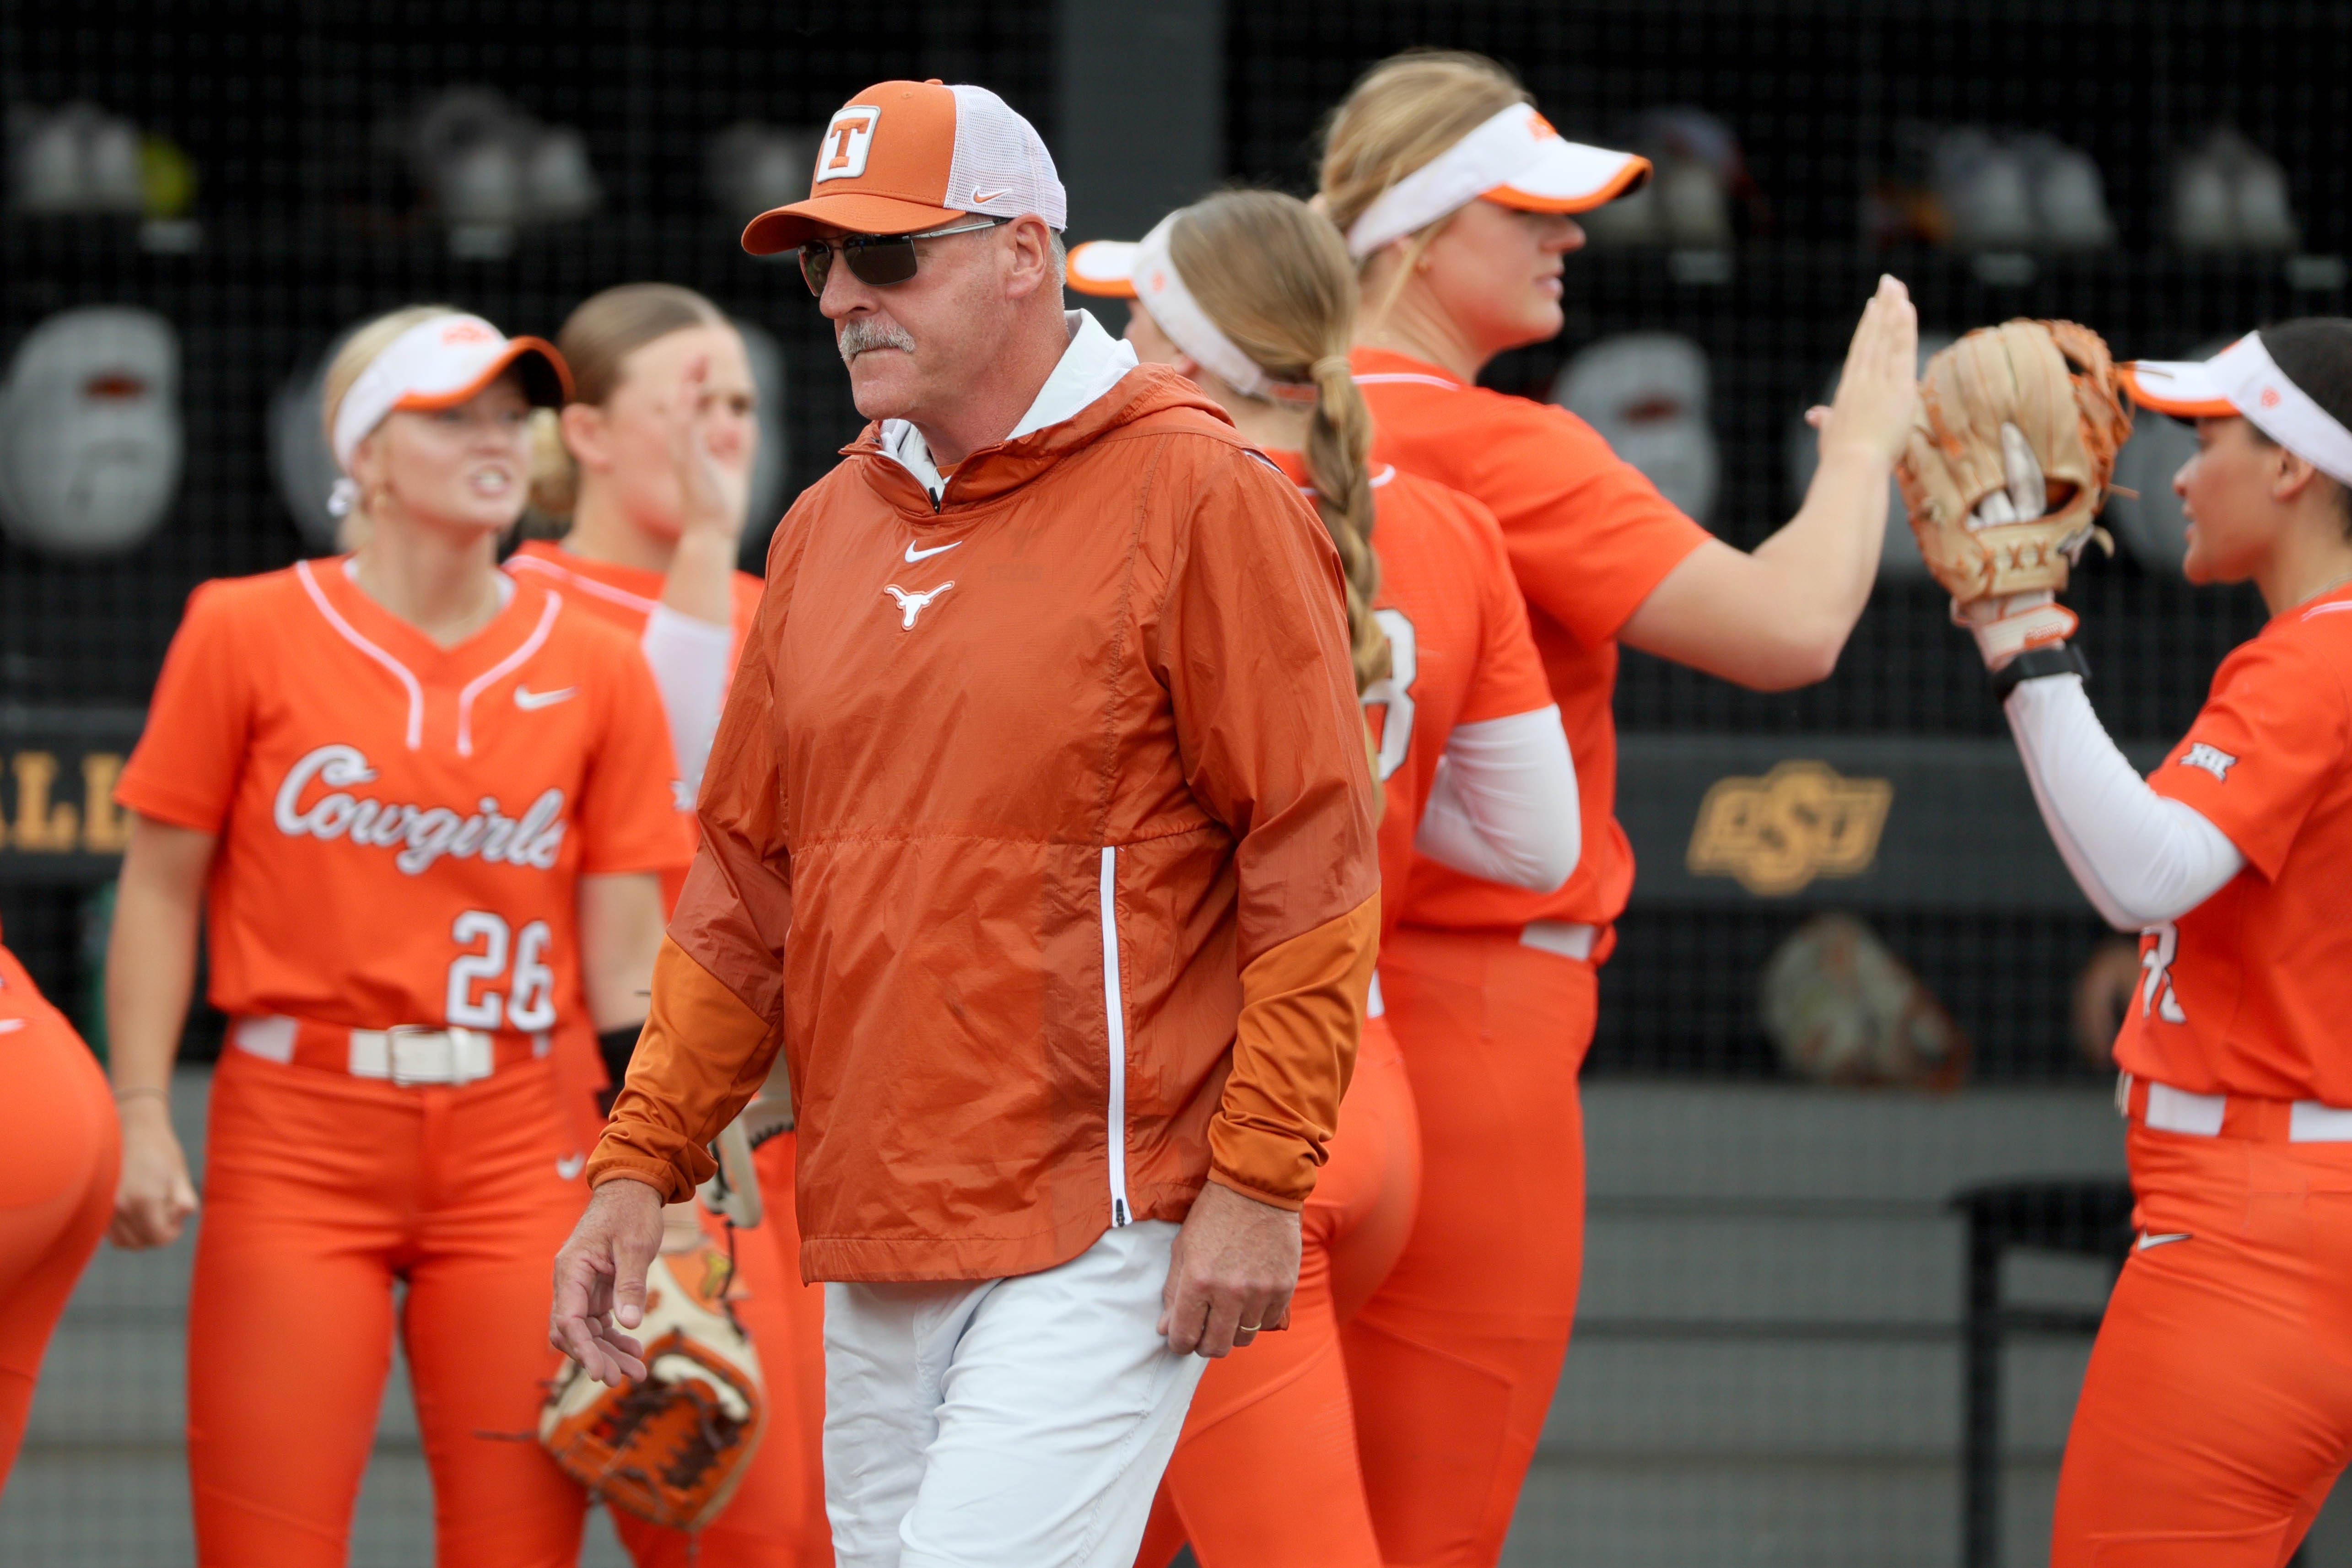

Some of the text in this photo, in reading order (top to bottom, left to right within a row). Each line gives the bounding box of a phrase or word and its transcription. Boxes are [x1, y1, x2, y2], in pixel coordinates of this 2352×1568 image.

[829, 117, 871, 170] T
[0, 749, 137, 853] LL
[273, 744, 566, 875] Cowgirls
[446, 910, 555, 1032] 26
